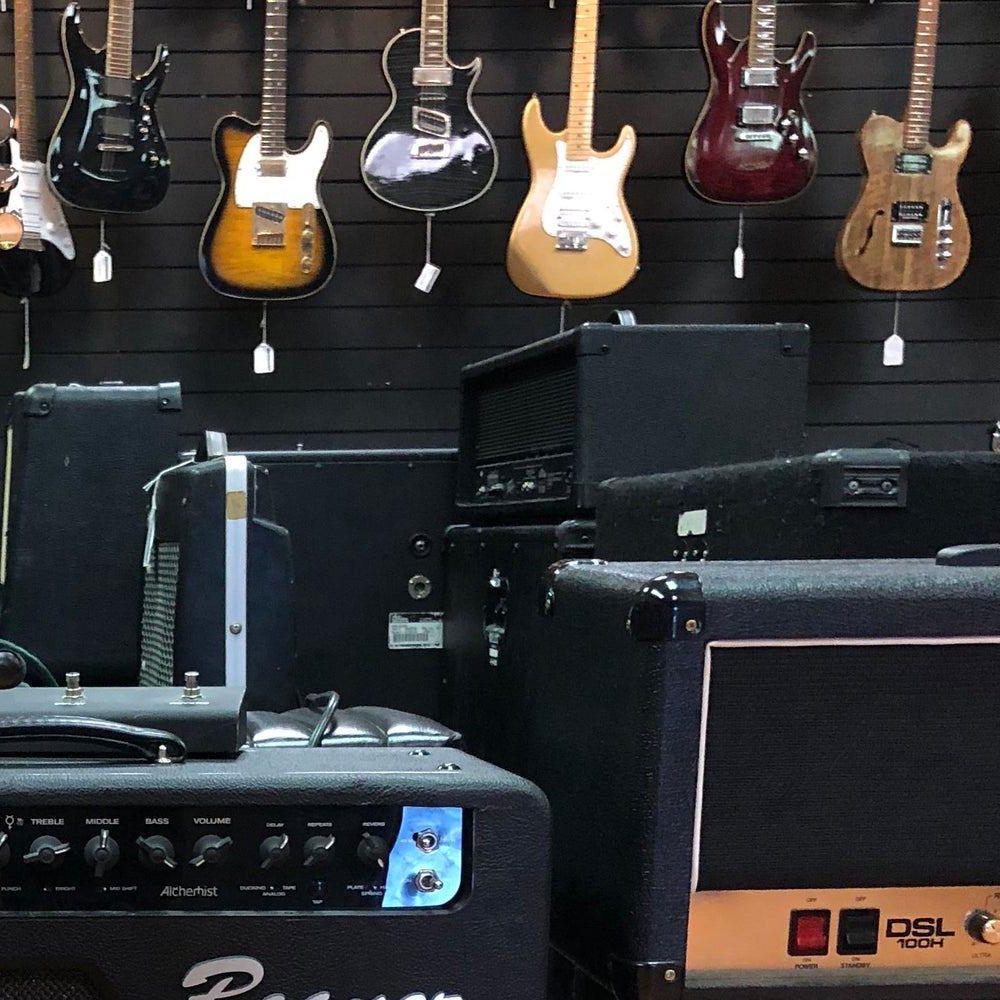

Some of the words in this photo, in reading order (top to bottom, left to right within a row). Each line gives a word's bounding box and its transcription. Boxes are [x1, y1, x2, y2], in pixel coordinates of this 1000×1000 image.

[30, 818, 65, 826] TREBLE
[85, 818, 120, 826] MIDDLE
[145, 817, 170, 825] BASS
[193, 817, 232, 825] VOLUME
[160, 885, 219, 897] Alchemist
[885, 917, 956, 938] DSL
[896, 938, 944, 949] 100H
